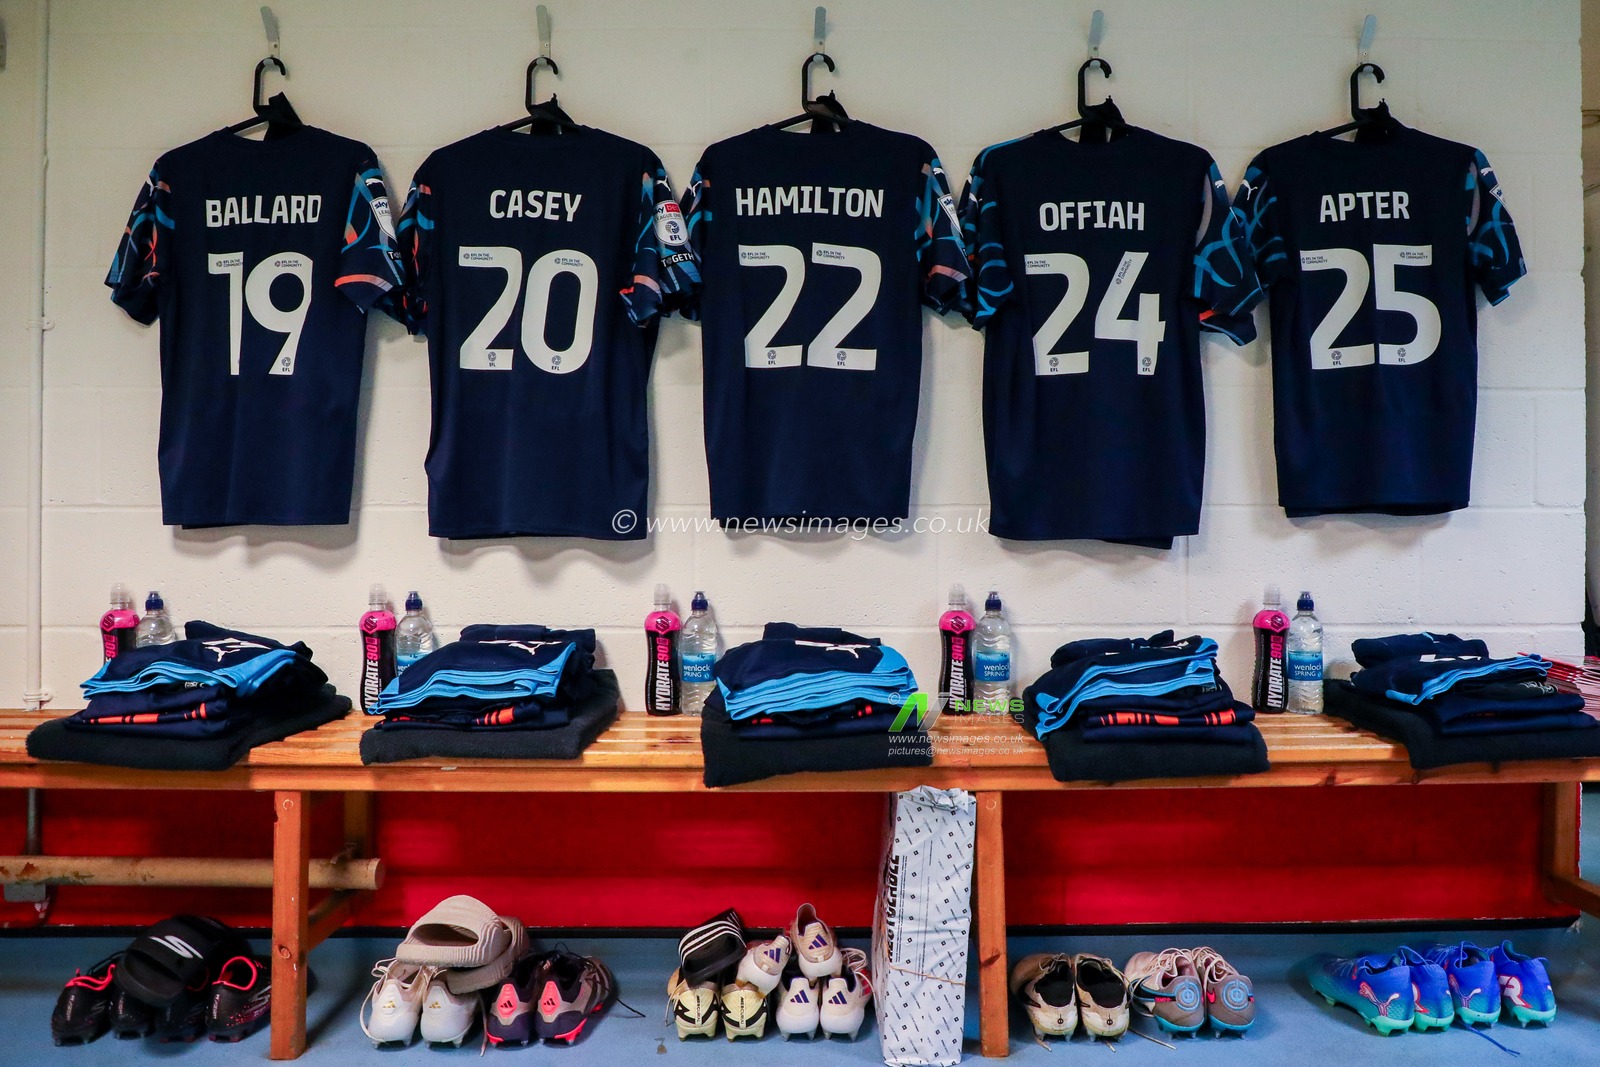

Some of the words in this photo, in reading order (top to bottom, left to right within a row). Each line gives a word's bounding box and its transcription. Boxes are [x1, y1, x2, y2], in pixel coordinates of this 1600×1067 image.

[206, 195, 321, 227] BALLARD
[490, 190, 582, 221] CASEY
[736, 186, 884, 217] HAMILTON
[1040, 201, 1145, 231] OFFIAH
[1320, 192, 1410, 223] APTER
[208, 252, 313, 375] 19
[459, 246, 598, 374] 20
[739, 243, 881, 370] 22
[1025, 252, 1165, 375] 24
[1300, 244, 1441, 369] 25
[684, 664, 710, 672] wenlock
